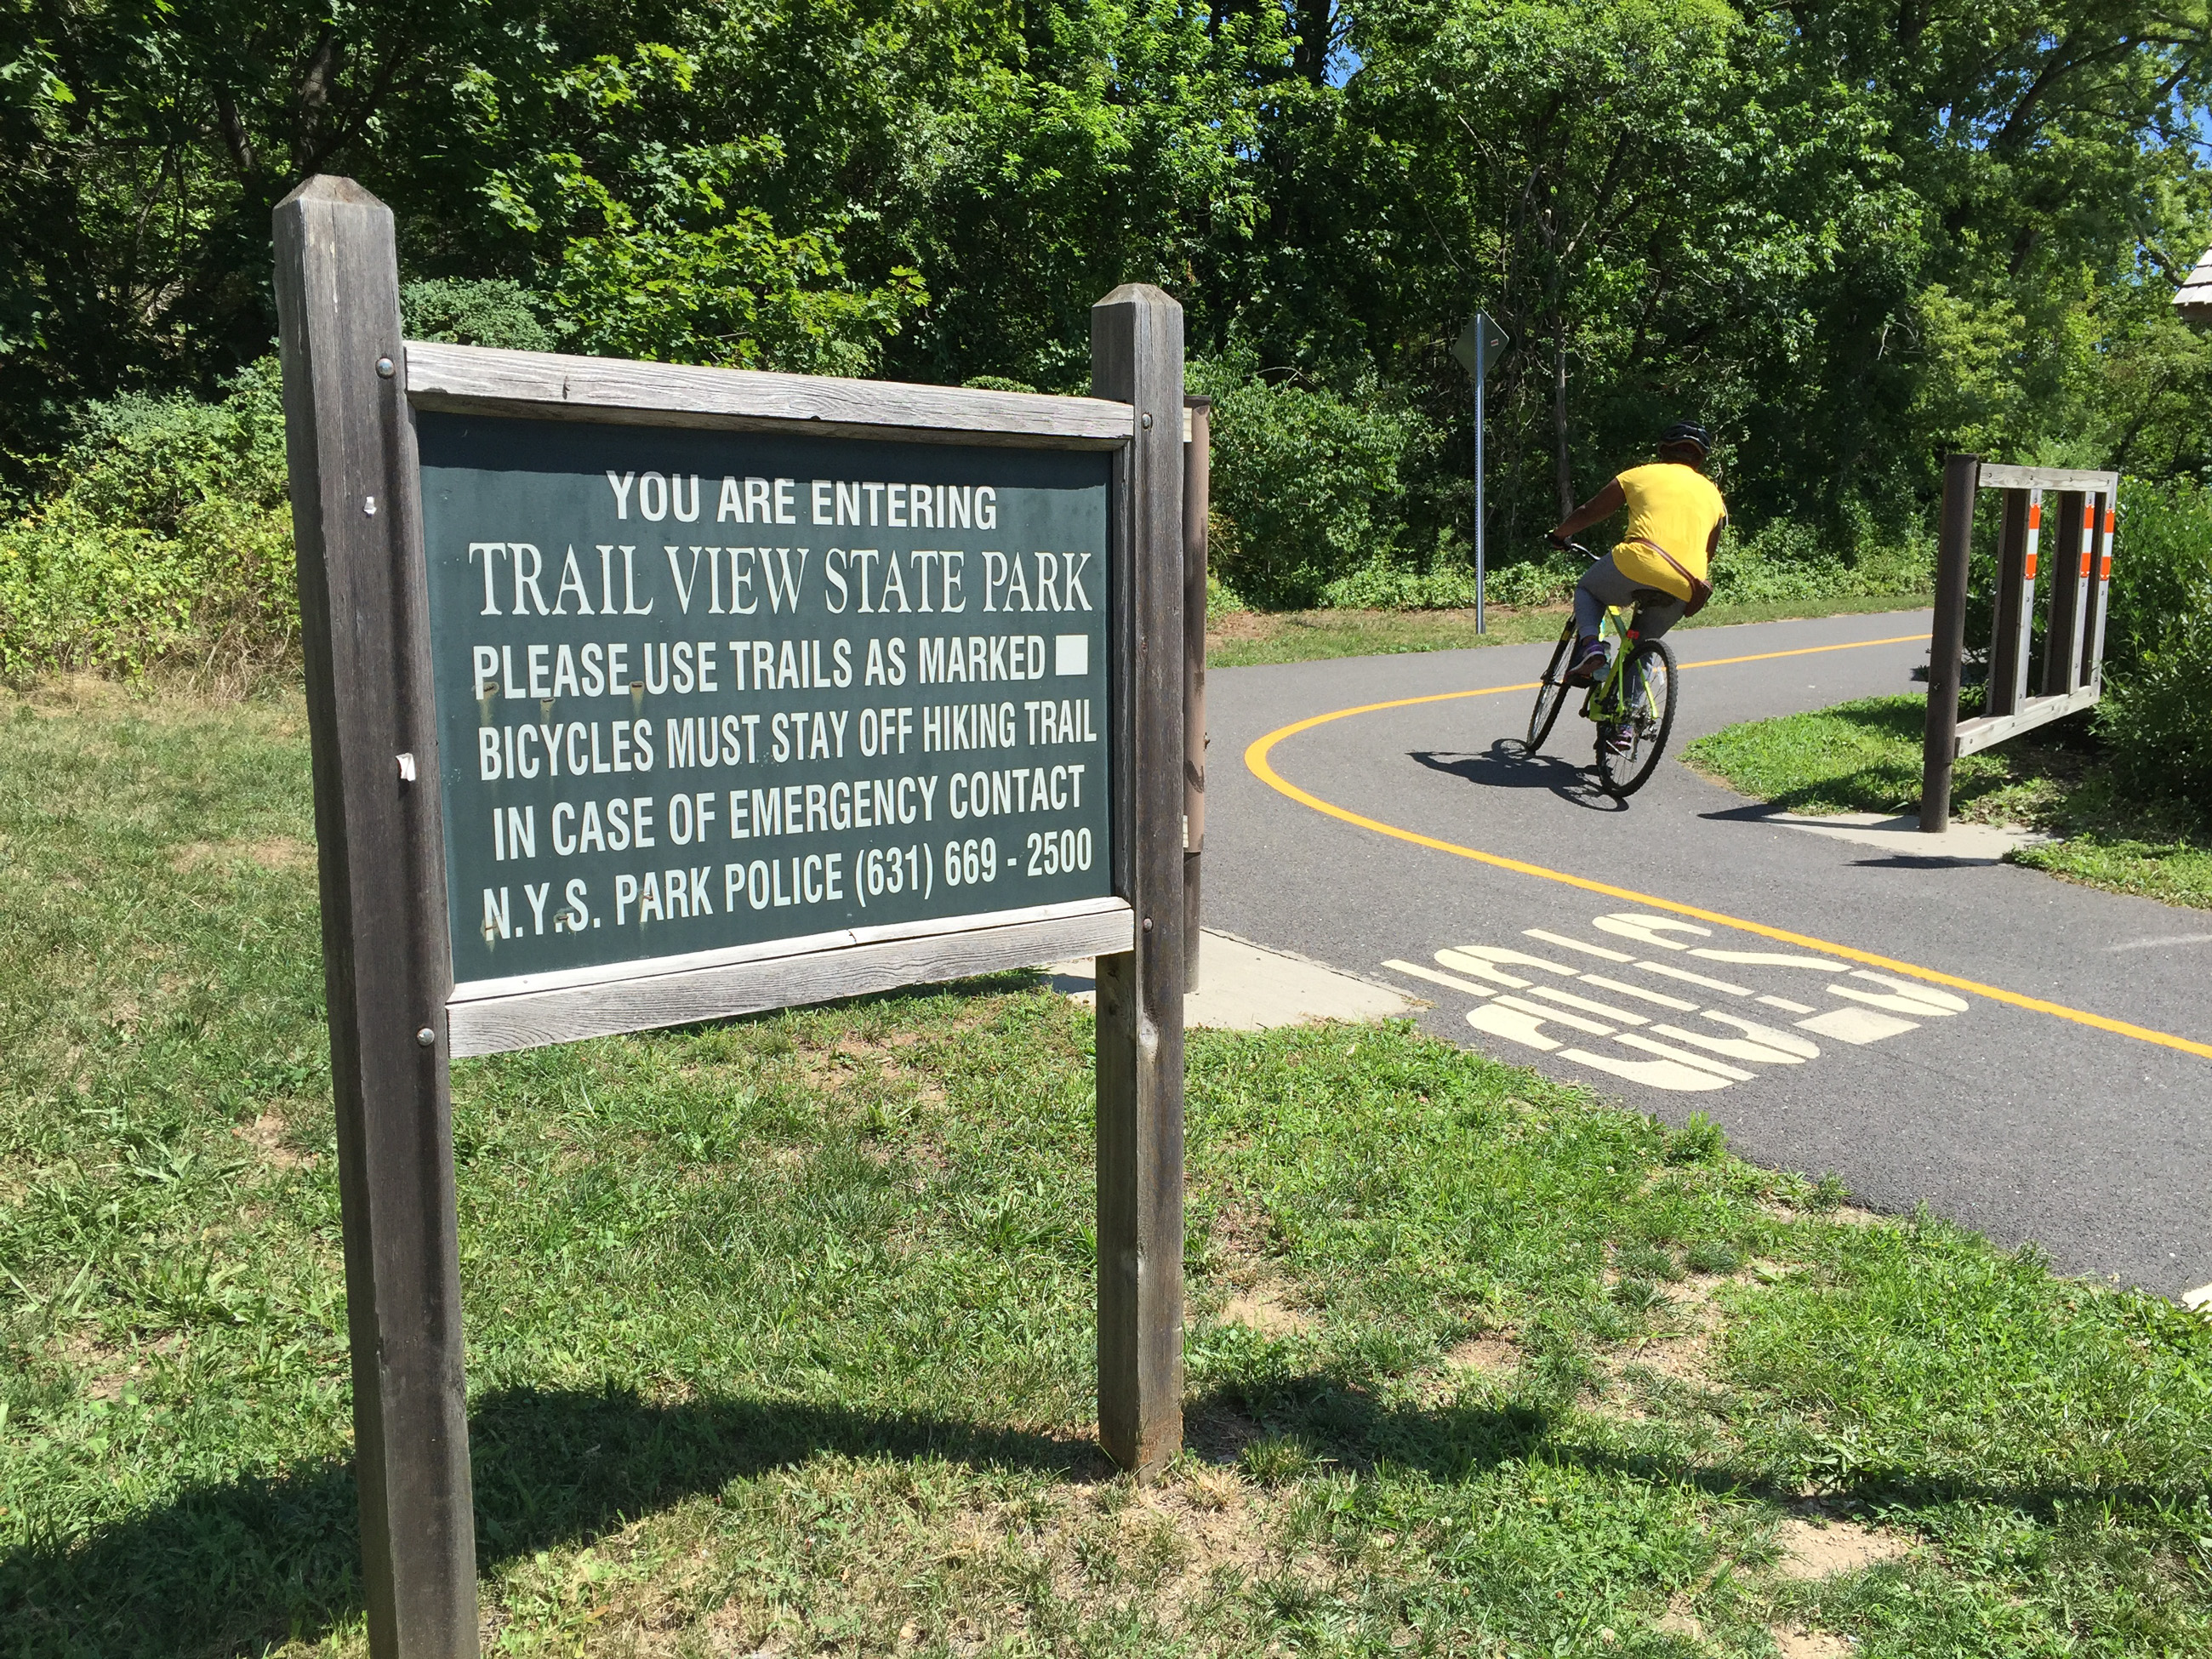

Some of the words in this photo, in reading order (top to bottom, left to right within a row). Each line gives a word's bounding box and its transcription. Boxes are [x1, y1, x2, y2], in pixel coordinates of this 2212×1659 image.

[607, 473, 699, 522] YOU
[717, 477, 795, 524] ARE
[812, 481, 995, 529] ENTERING
[470, 543, 653, 615] TRAIL
[664, 546, 809, 614] VIEW
[826, 549, 966, 613] STATE
[982, 552, 1092, 612] PARK
[474, 643, 630, 699] PLEASE
[644, 641, 717, 694] USE
[730, 639, 852, 690] TRAILS
[865, 637, 906, 686] AS
[920, 636, 1045, 683] MARKED
[479, 719, 653, 780] BICYCLES
[667, 715, 760, 768] MUST
[772, 710, 848, 762] STAY
[860, 708, 912, 756] OFF
[924, 702, 1015, 751] HIKING
[1024, 699, 1097, 744] TRAIL
[494, 806, 535, 860] IN
[553, 797, 654, 855] CASE
[670, 793, 715, 845] OF
[730, 776, 938, 839] EMERGENCY
[950, 765, 1084, 818] CONTACT
[484, 879, 600, 941] N.Y.S.
[616, 866, 713, 925] PARK
[726, 853, 842, 912] POLICE
[856, 843, 932, 907] (631)
[945, 838, 996, 886] 669
[1028, 828, 1091, 876] 2500
[1381, 913, 1970, 1092] STOP
